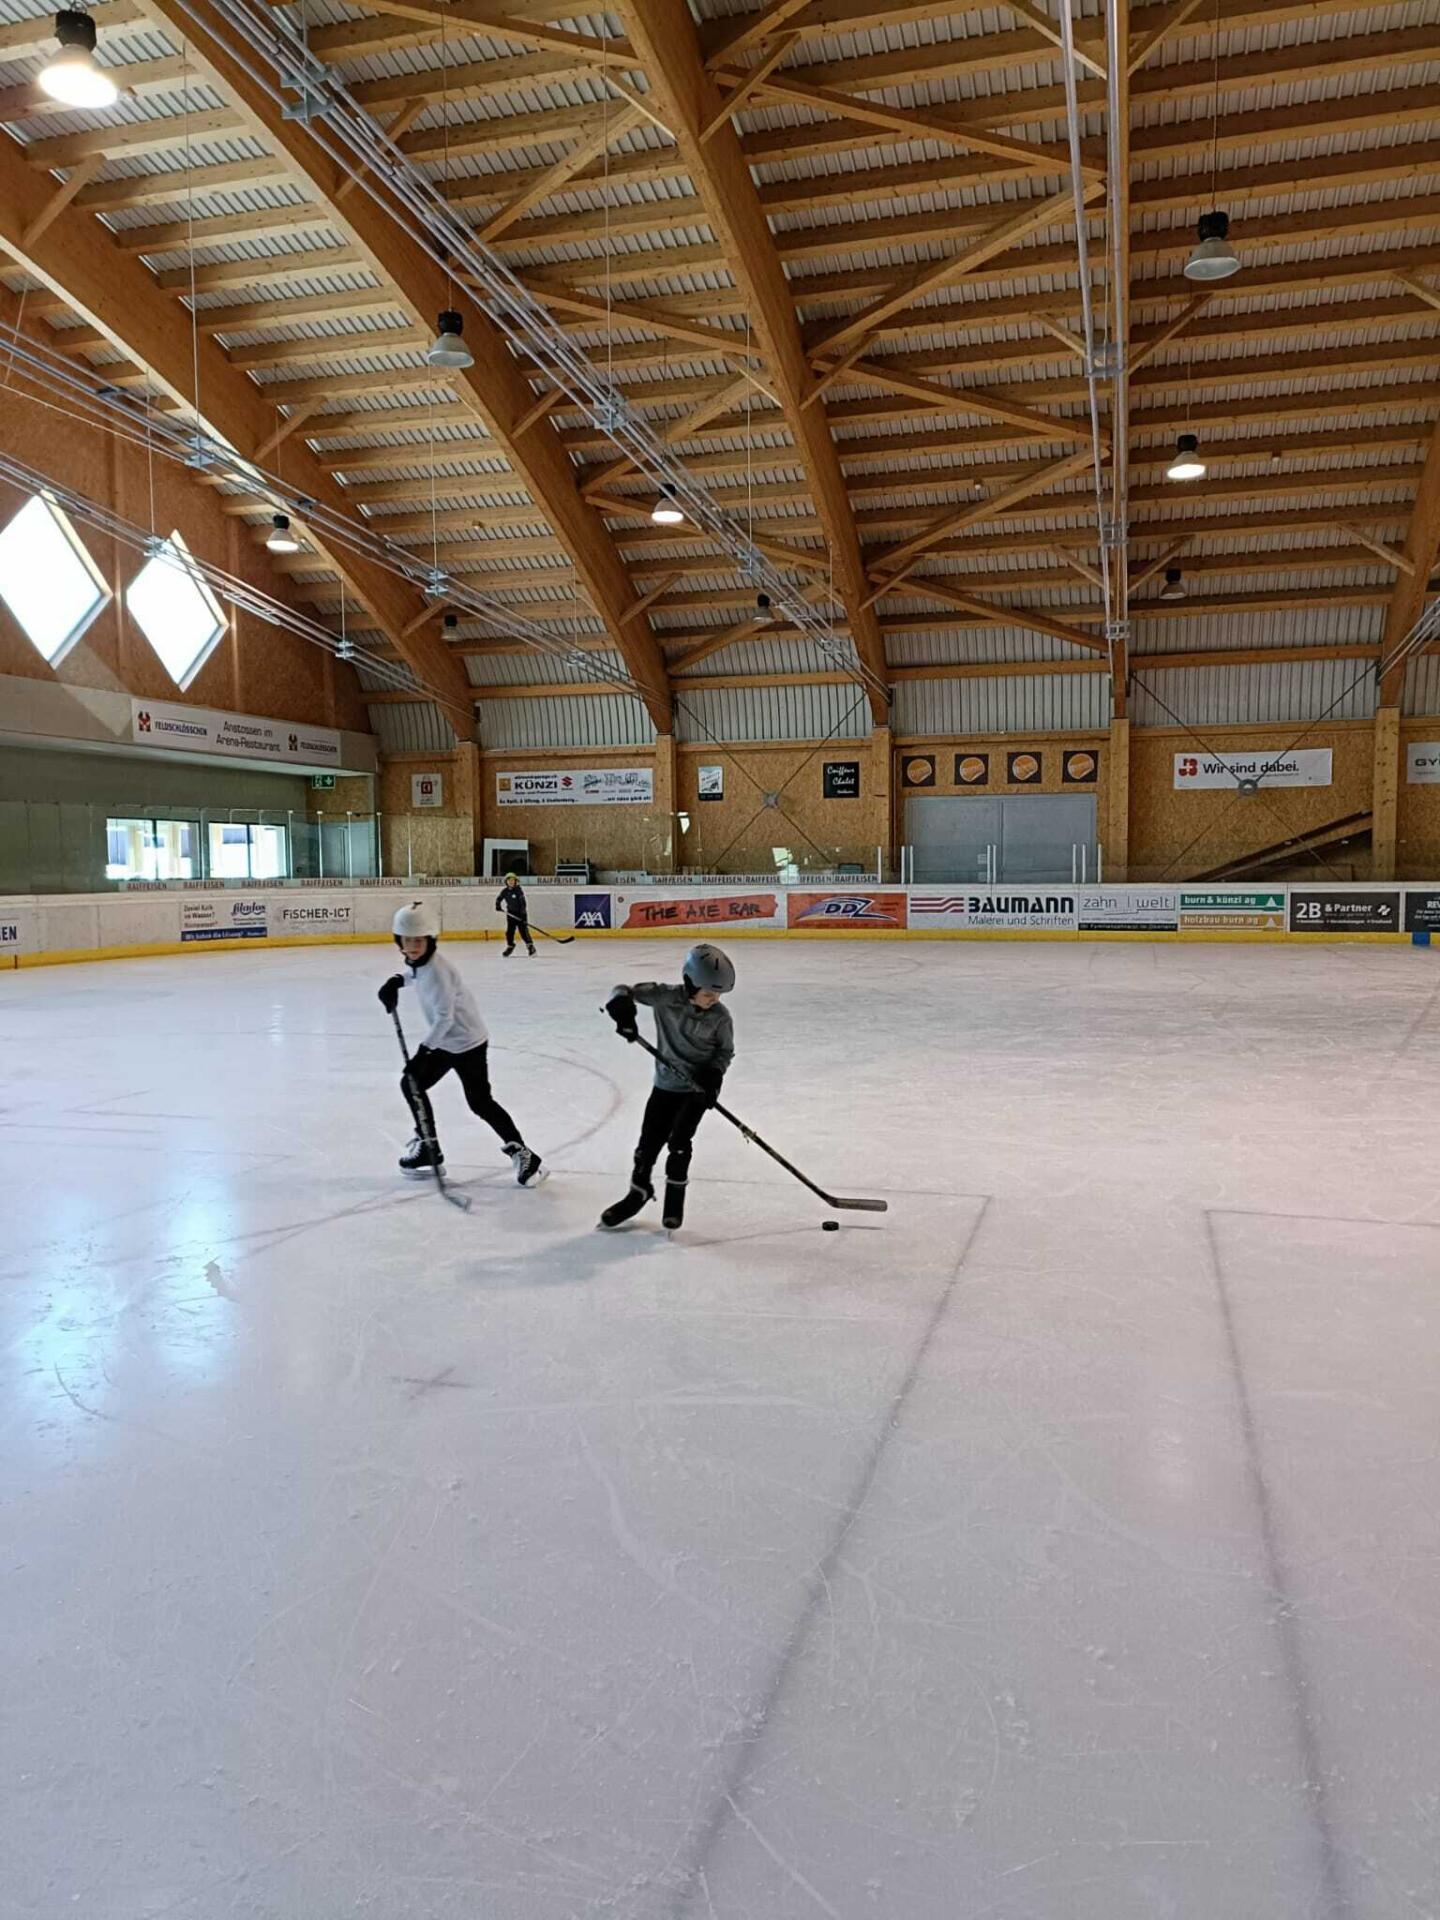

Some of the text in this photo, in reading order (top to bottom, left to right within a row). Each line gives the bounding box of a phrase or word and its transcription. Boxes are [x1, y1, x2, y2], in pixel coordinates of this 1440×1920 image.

[223, 720, 273, 737] Anstossen im
[216, 734, 281, 752] Arena-Restaurant
[1203, 760, 1299, 774] Wir sind dabei.
[1415, 758, 1440, 766] GY
[514, 779, 558, 790] KÜNZI
[301, 879, 343, 888] RAIFFEISEN
[359, 879, 403, 887] RAIFFEISEN
[418, 878, 462, 886] RAIFFEISEN
[745, 876, 781, 884] RAIFFEISE
[834, 875, 878, 883] RAIFFEISEN
[968, 897, 1074, 913] BAUMANN
[1083, 896, 1170, 908] zahn welt
[1184, 896, 1256, 905] burn & künzi ag
[640, 904, 761, 921] THE AXE BAR
[1296, 902, 1321, 918] 2B
[1325, 904, 1332, 912] &
[1334, 903, 1373, 912] Partner
[575, 911, 604, 927] AXA
[968, 916, 1005, 925] Malerei
[1007, 915, 1027, 925] und
[1030, 914, 1074, 925] Schriften
[0, 925, 17, 941] EN
